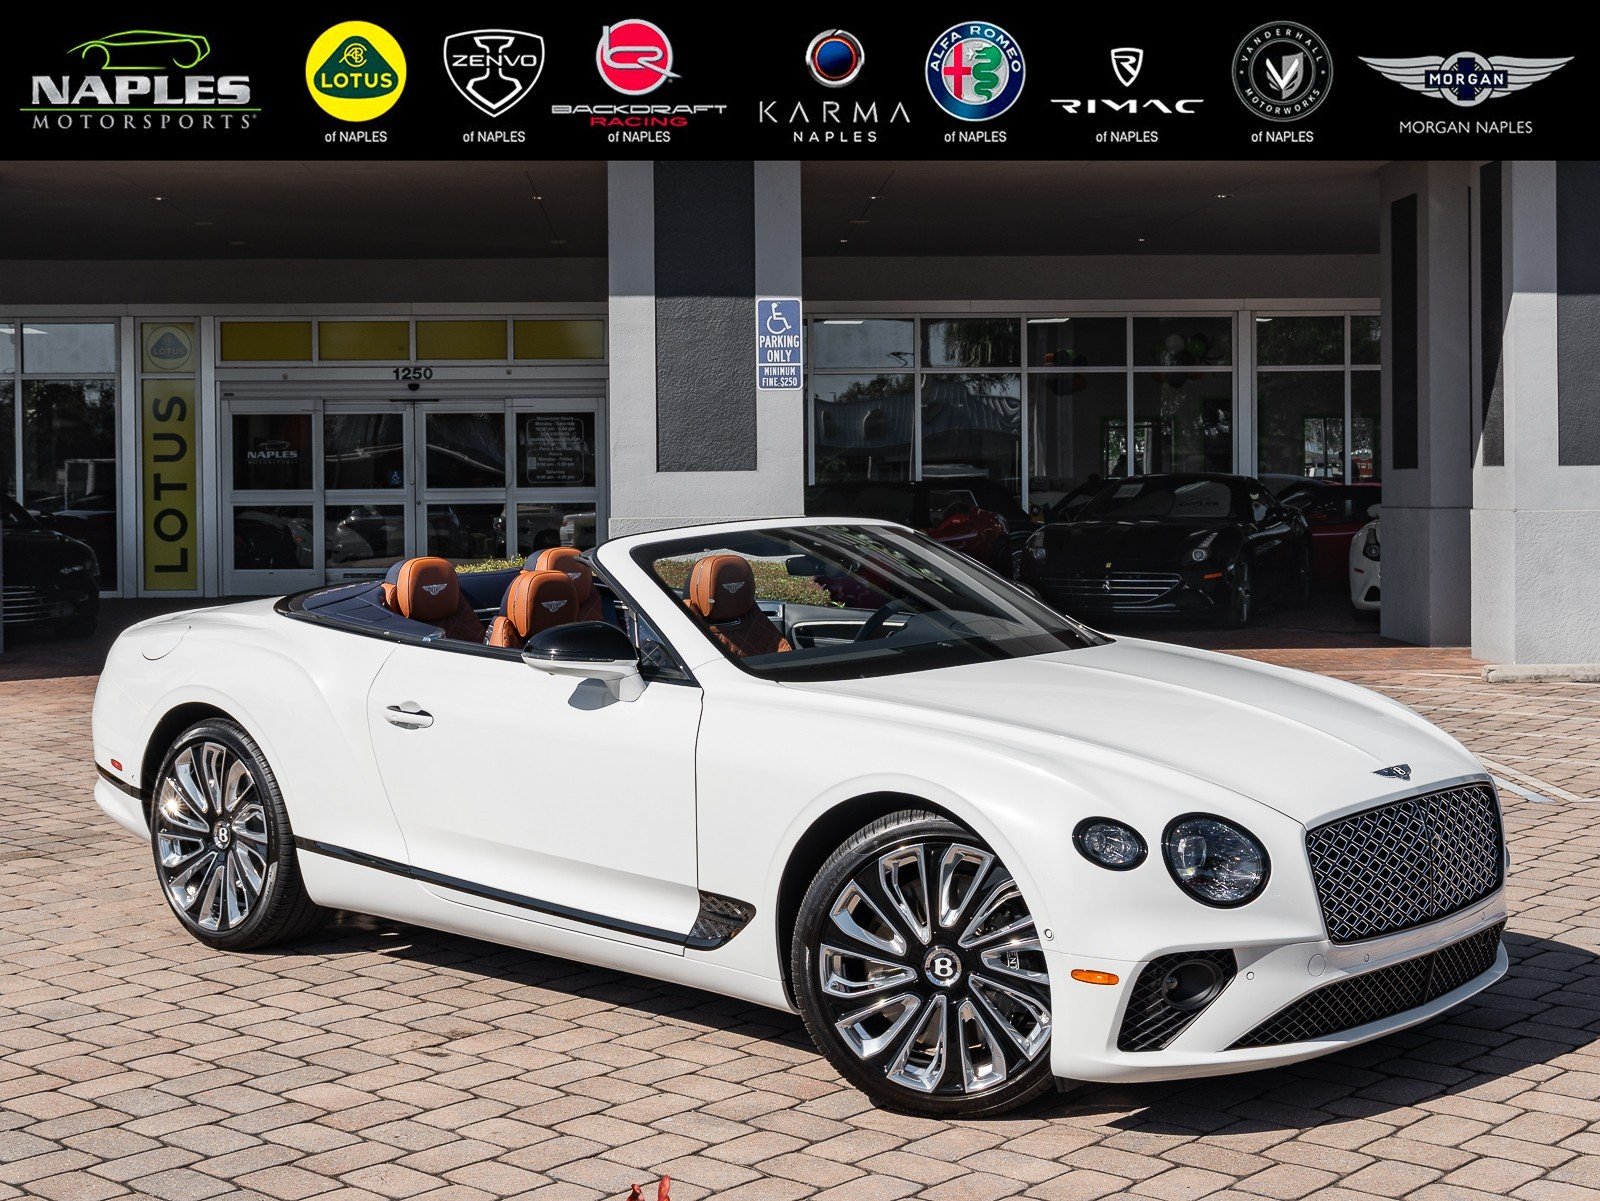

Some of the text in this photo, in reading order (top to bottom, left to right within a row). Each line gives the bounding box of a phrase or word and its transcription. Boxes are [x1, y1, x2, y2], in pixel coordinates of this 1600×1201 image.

[759, 335, 800, 348] PARKING
[153, 347, 185, 355] LOTUS
[766, 350, 792, 363] ONLY
[393, 367, 433, 380] 1250
[764, 367, 796, 376] MINIMUM
[762, 376, 798, 387] FINE $250
[247, 450, 298, 459] NAPLES
[152, 395, 189, 573] LOTUS
[934, 957, 954, 977] B
